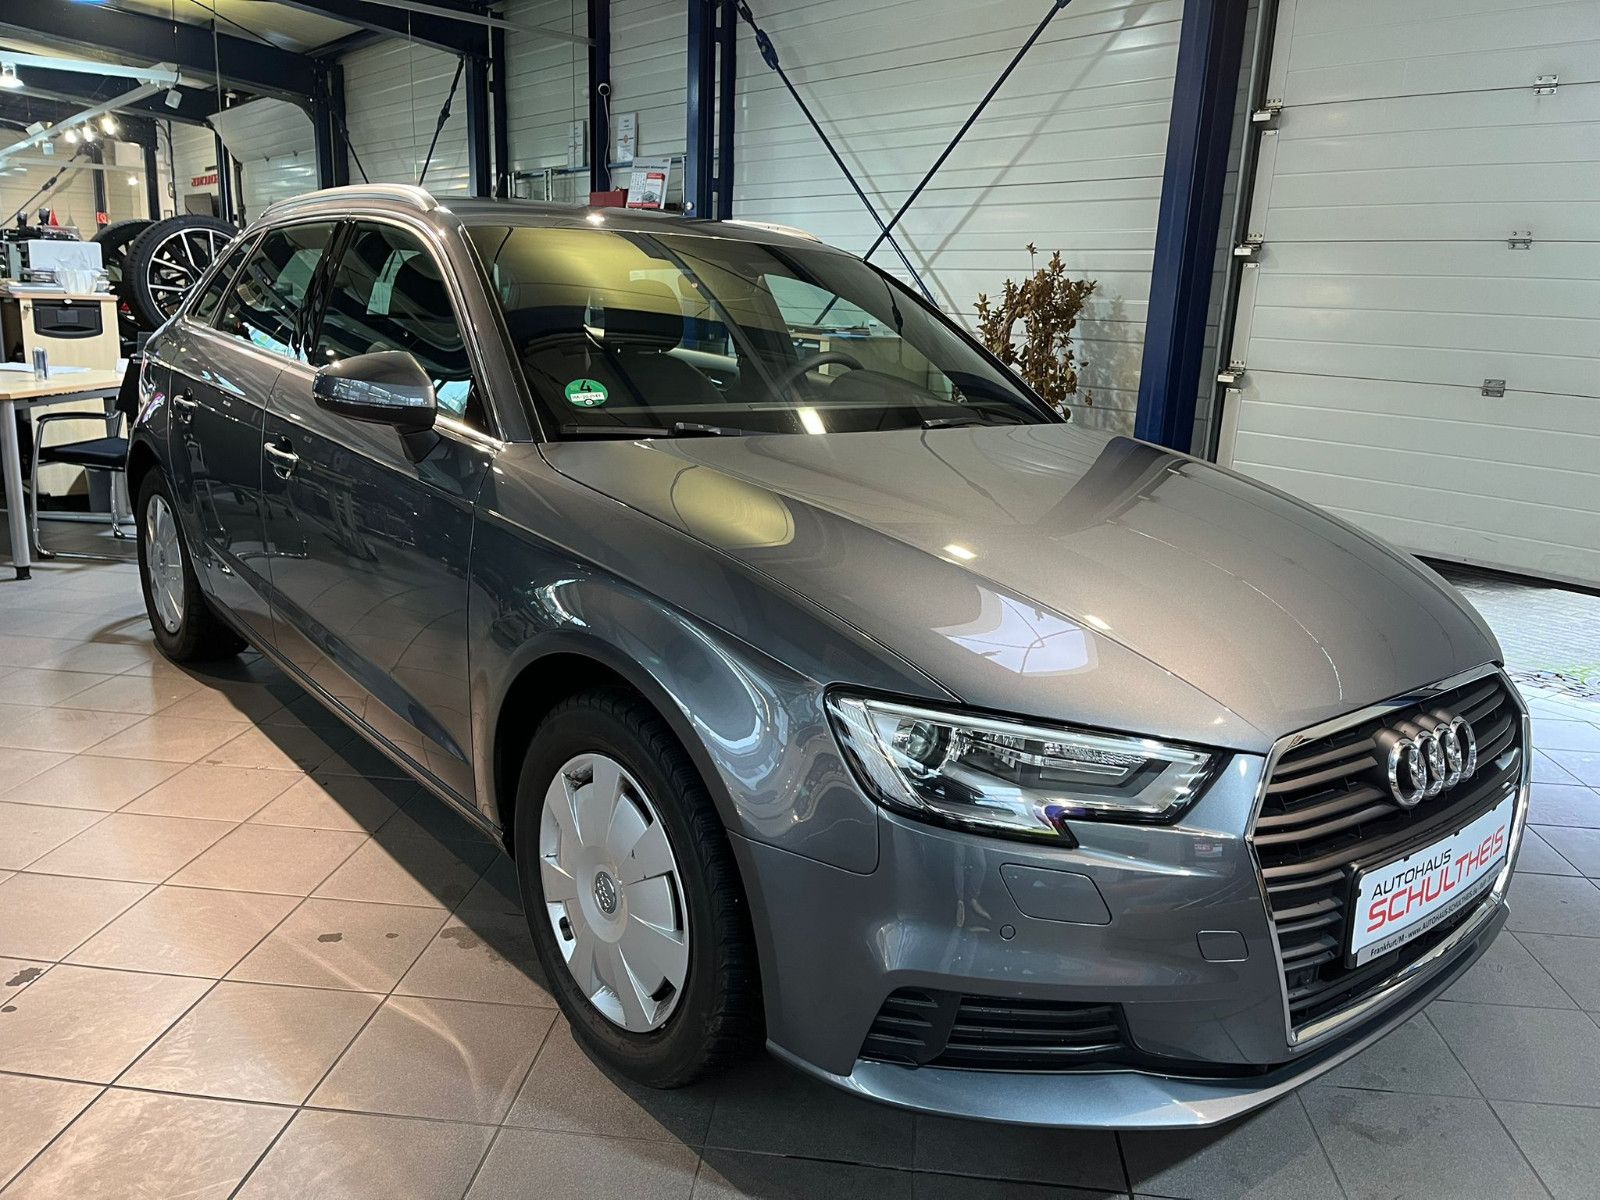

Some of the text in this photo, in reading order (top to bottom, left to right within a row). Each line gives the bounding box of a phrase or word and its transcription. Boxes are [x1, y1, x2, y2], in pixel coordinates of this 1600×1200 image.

[580, 380, 593, 392] 4
[1366, 824, 1505, 933] SCHULTHEIS
[1371, 849, 1452, 900] AUTOHAUS
